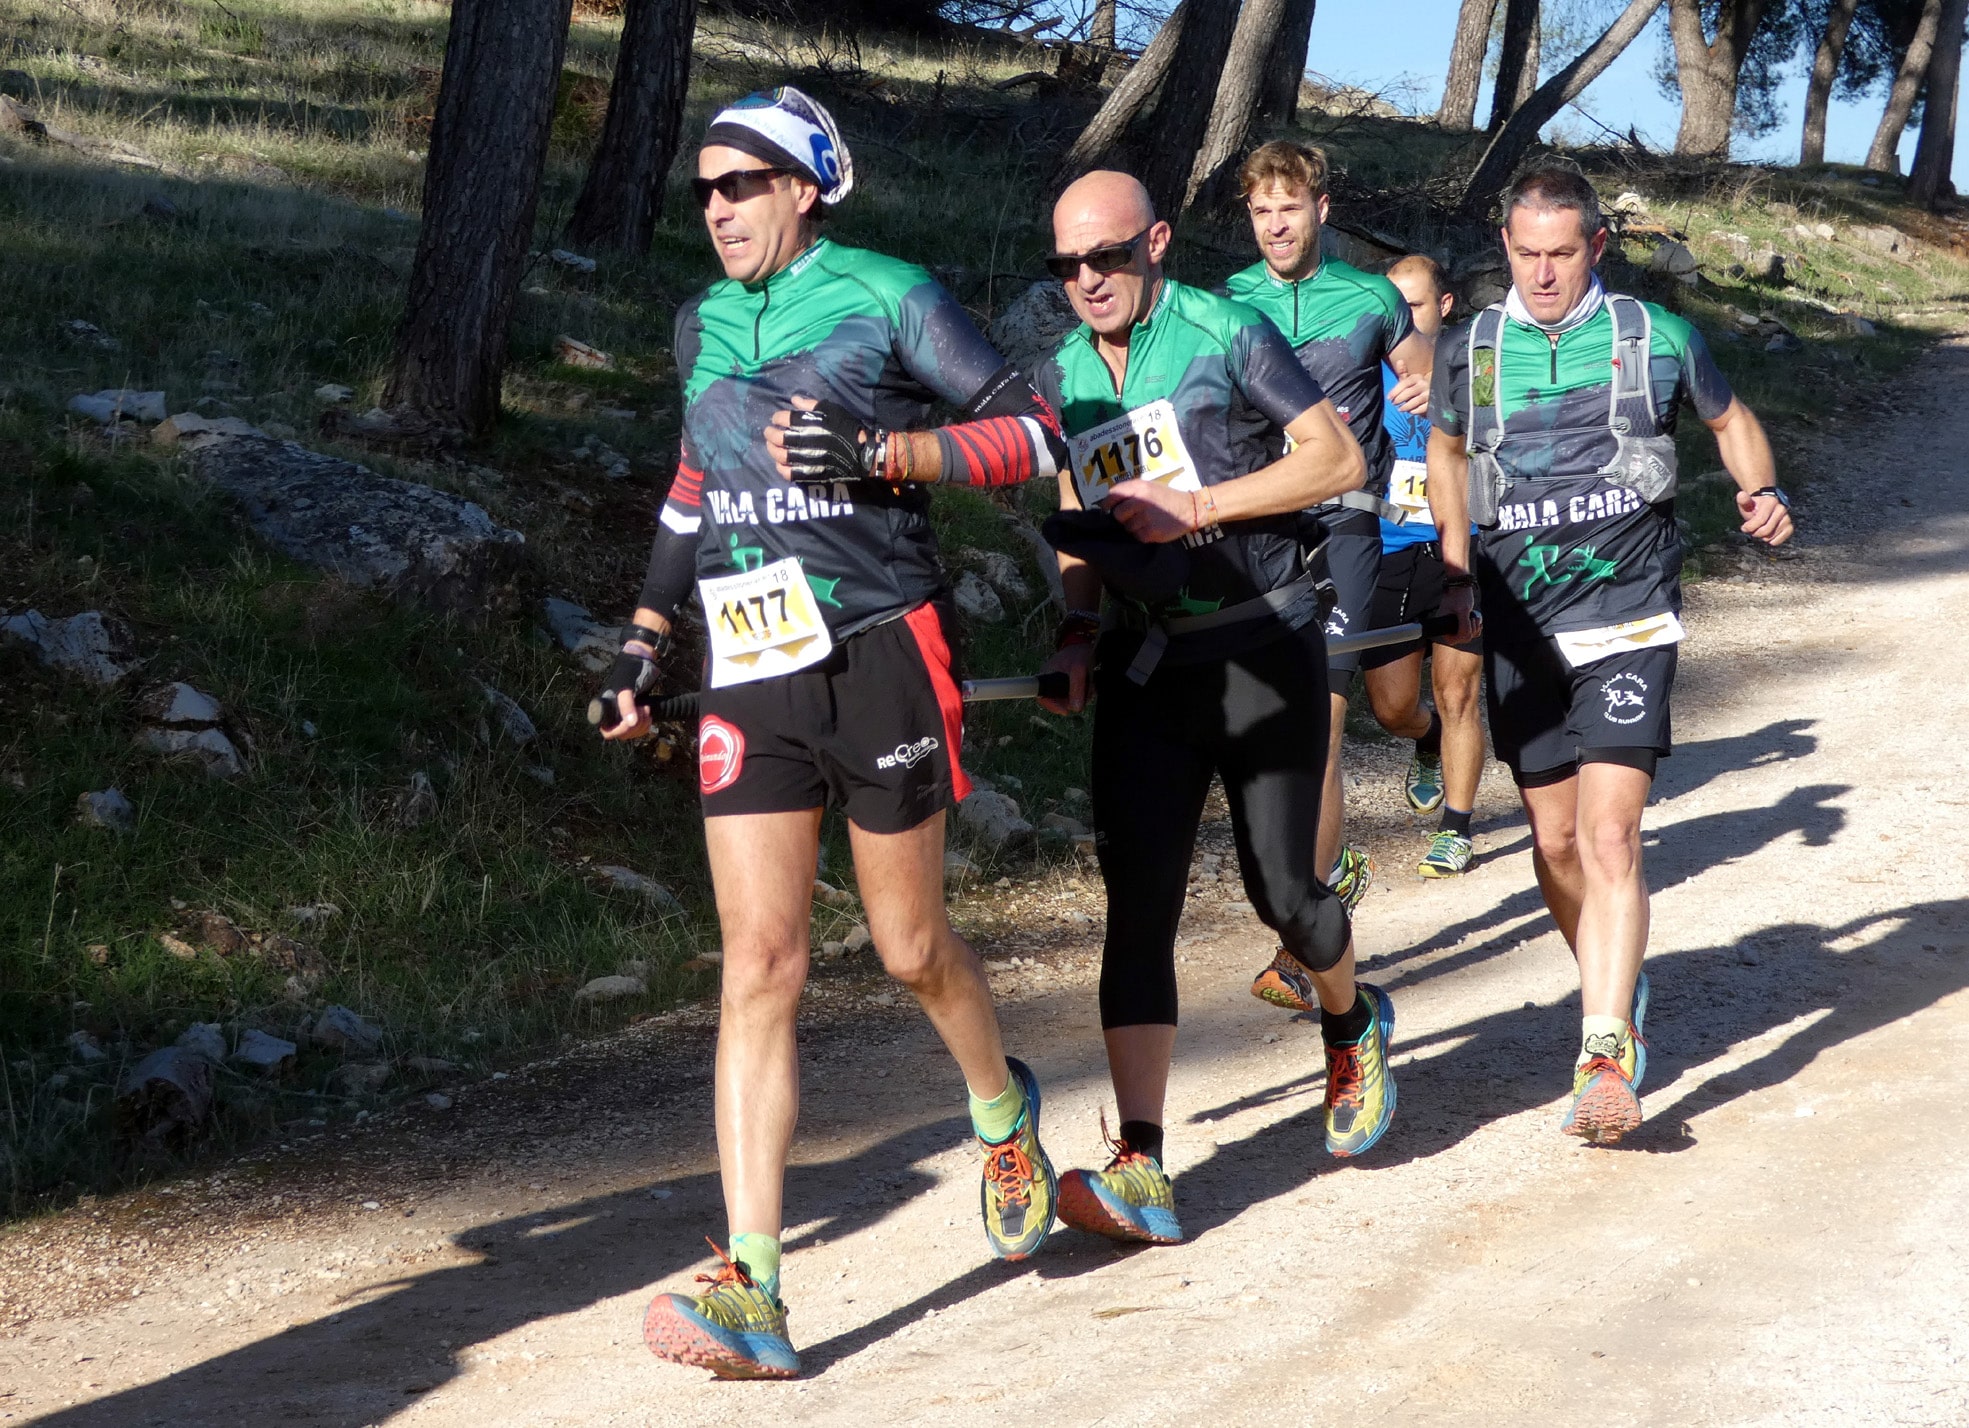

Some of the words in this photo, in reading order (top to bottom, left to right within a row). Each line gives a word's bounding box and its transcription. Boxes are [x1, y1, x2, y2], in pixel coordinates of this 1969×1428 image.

[1148, 409, 1162, 423] 18
[1090, 427, 1163, 480] 1176
[1405, 475, 1428, 497] 11
[767, 482, 854, 524] CARA
[1497, 499, 1560, 531] MALA
[1569, 488, 1640, 523] CARA
[773, 569, 789, 584] 18
[721, 588, 789, 634] 1177
[1331, 606, 1350, 624] CARA
[1625, 672, 1648, 692] CARA
